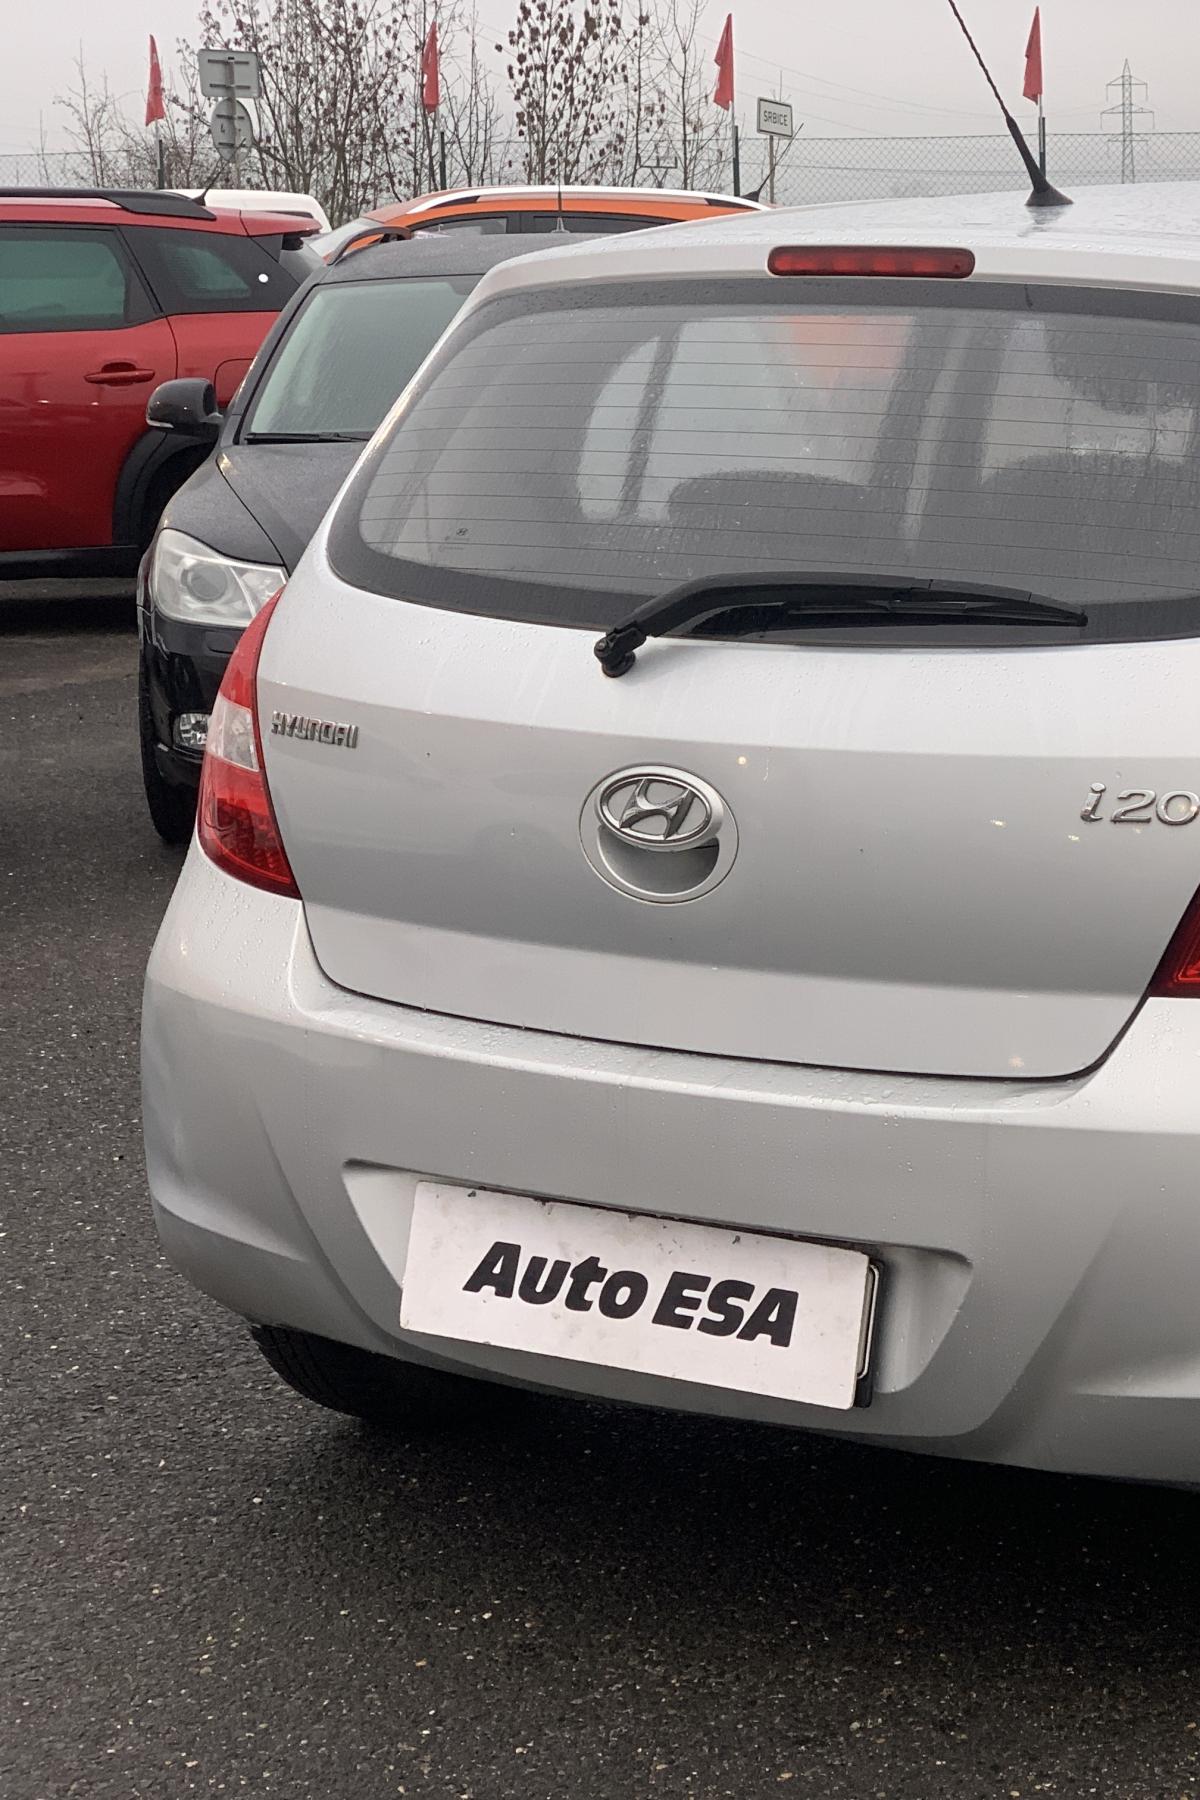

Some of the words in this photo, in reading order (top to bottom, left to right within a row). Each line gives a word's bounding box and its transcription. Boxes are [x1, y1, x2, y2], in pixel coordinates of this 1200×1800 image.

[763, 110, 788, 126] SRBICE
[271, 710, 359, 749] HYUNDAI
[1080, 782, 1200, 826] i20
[462, 1241, 649, 1320] Auto
[651, 1271, 799, 1348] ESA
